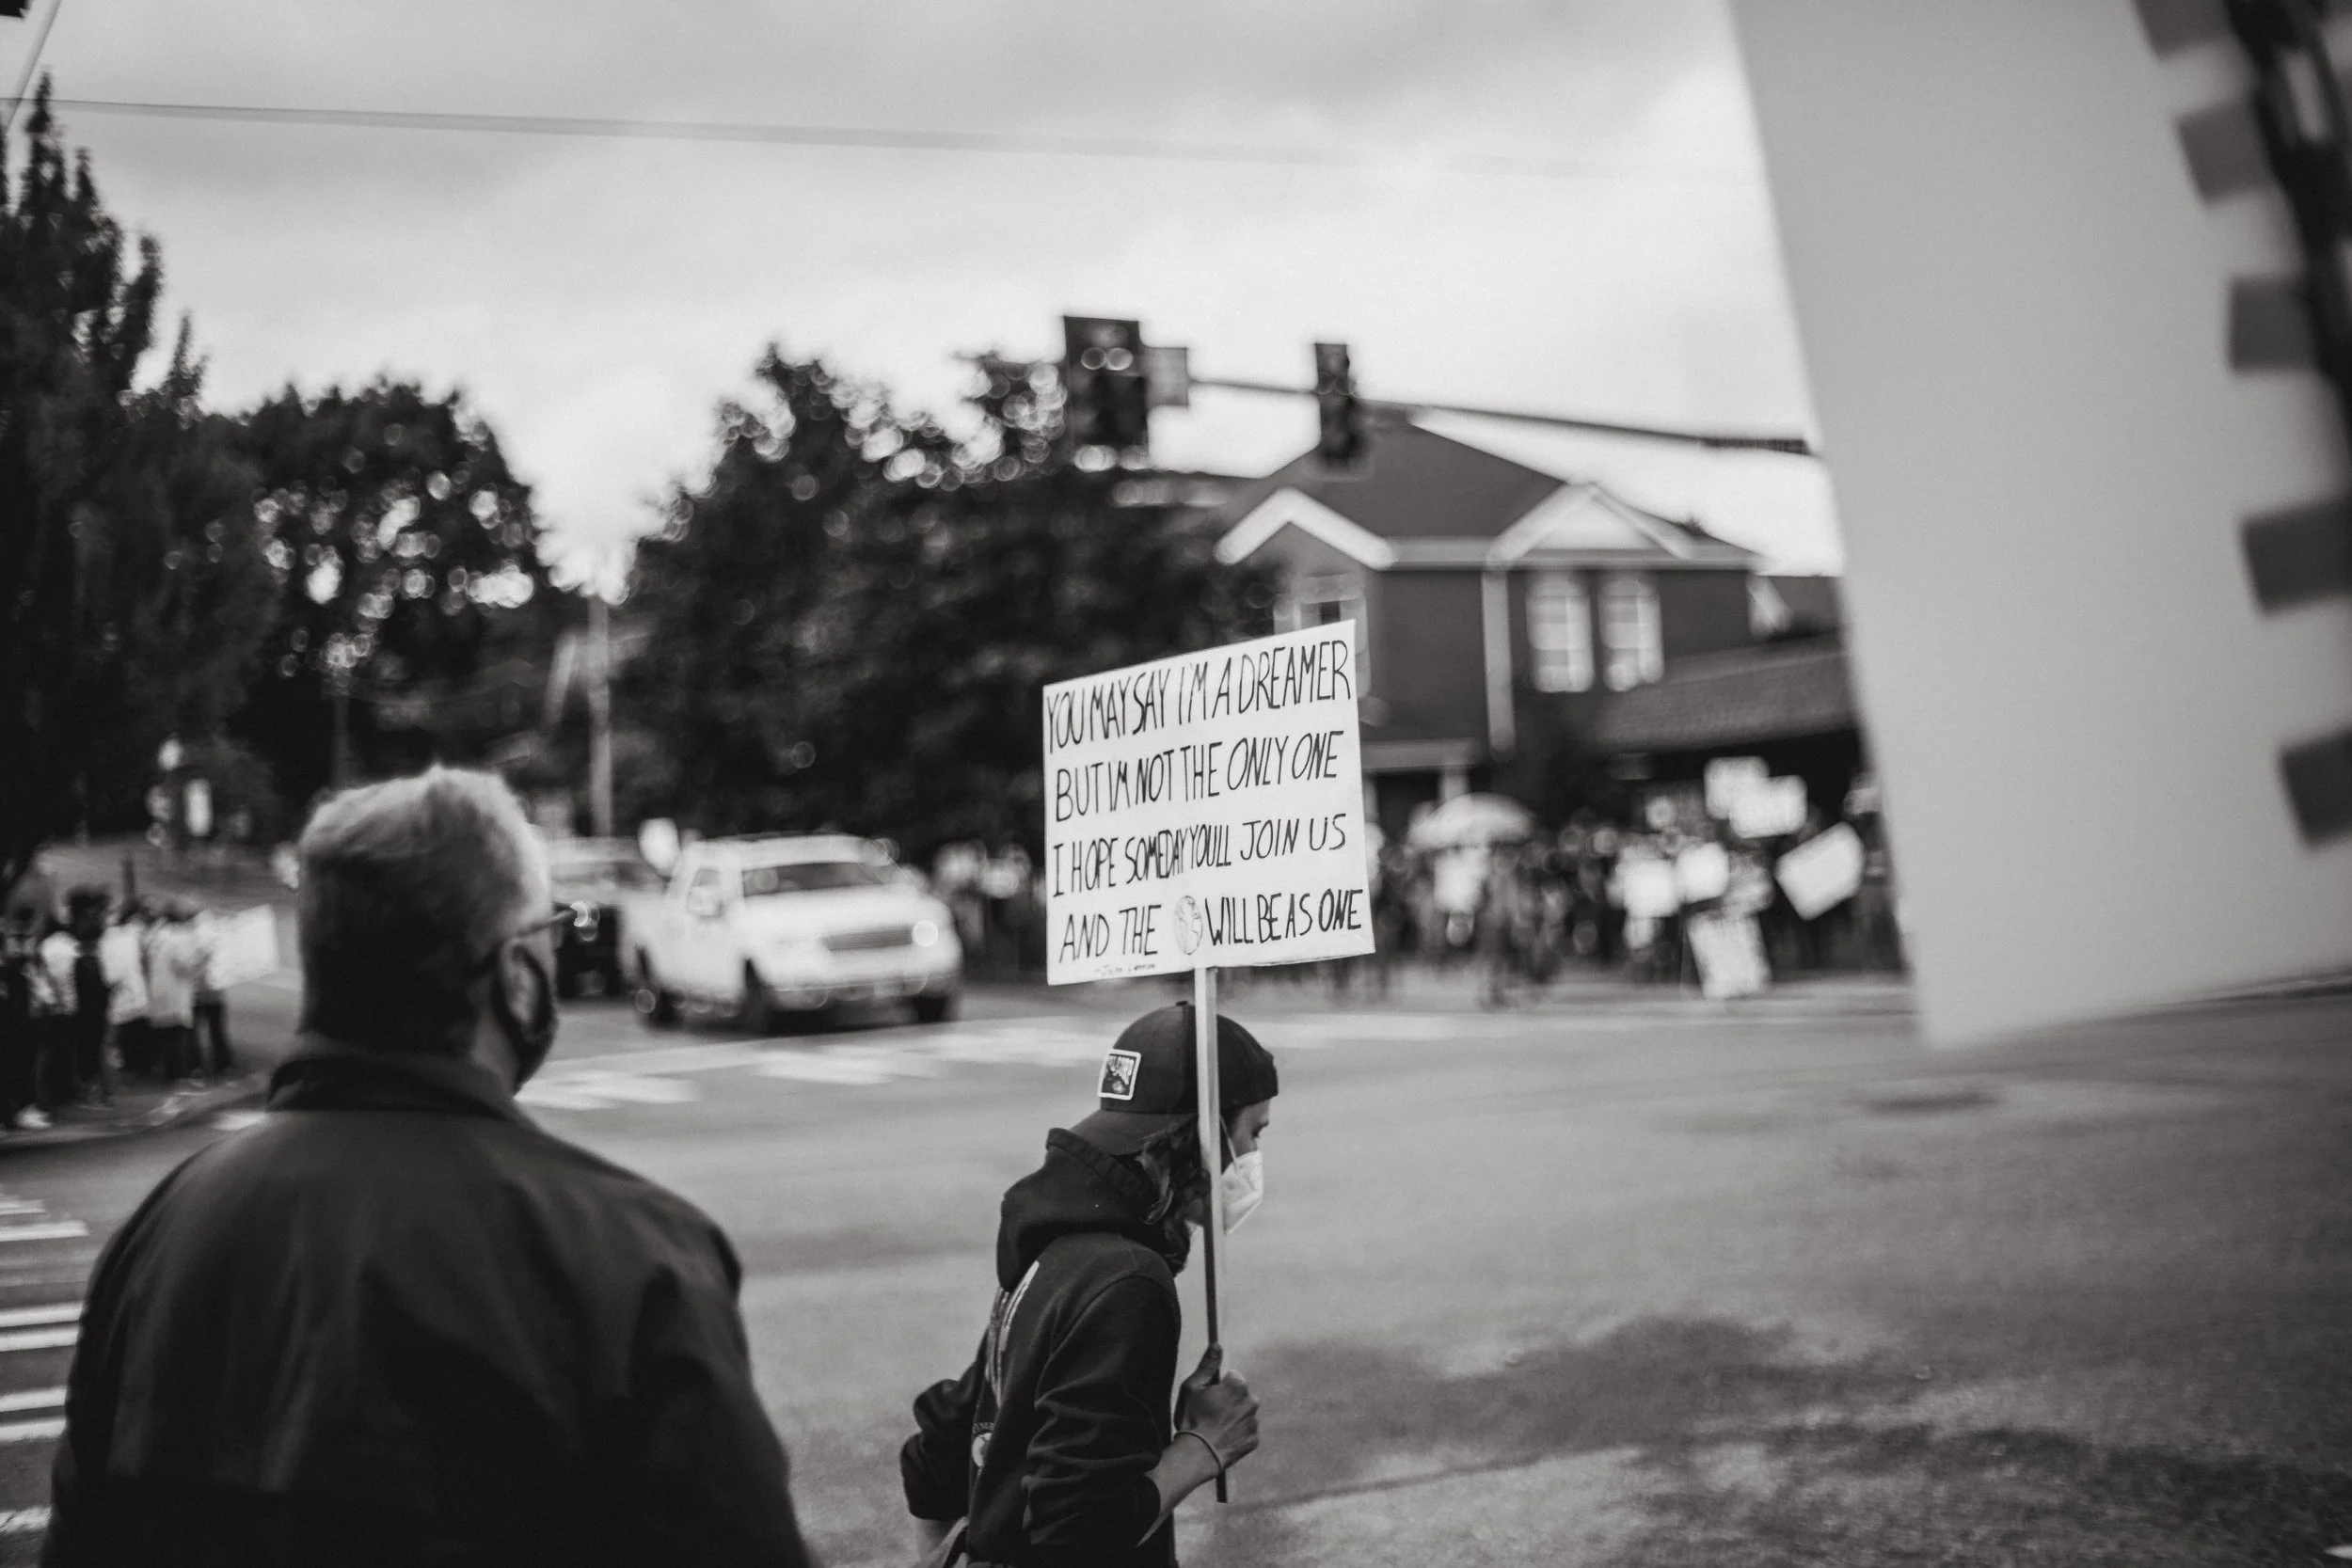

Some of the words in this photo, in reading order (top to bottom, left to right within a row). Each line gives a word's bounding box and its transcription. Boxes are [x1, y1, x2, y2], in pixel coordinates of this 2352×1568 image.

[1046, 689, 1085, 754] YOU
[1089, 676, 1131, 741] MAY
[1132, 668, 1170, 735] SAY
[1212, 657, 1232, 719] A
[1238, 641, 1351, 714] DREAMER
[1056, 762, 1104, 822] BUT
[1135, 749, 1174, 805] NOT
[1180, 741, 1222, 801] THE
[1227, 735, 1289, 790] ONLY
[1292, 730, 1344, 781] ONE
[1053, 843, 1064, 897] I
[1071, 837, 1119, 893] HOPE
[1125, 829, 1187, 884] SOMEDAY
[1240, 817, 1300, 861] JOIN
[1309, 813, 1346, 850] US
[1059, 913, 1110, 963] AND
[1119, 904, 1162, 956] THE
[1205, 896, 1253, 945] WILL
[1257, 892, 1281, 943] BE
[1285, 893, 1312, 939] AS
[1318, 888, 1363, 932] ONE
